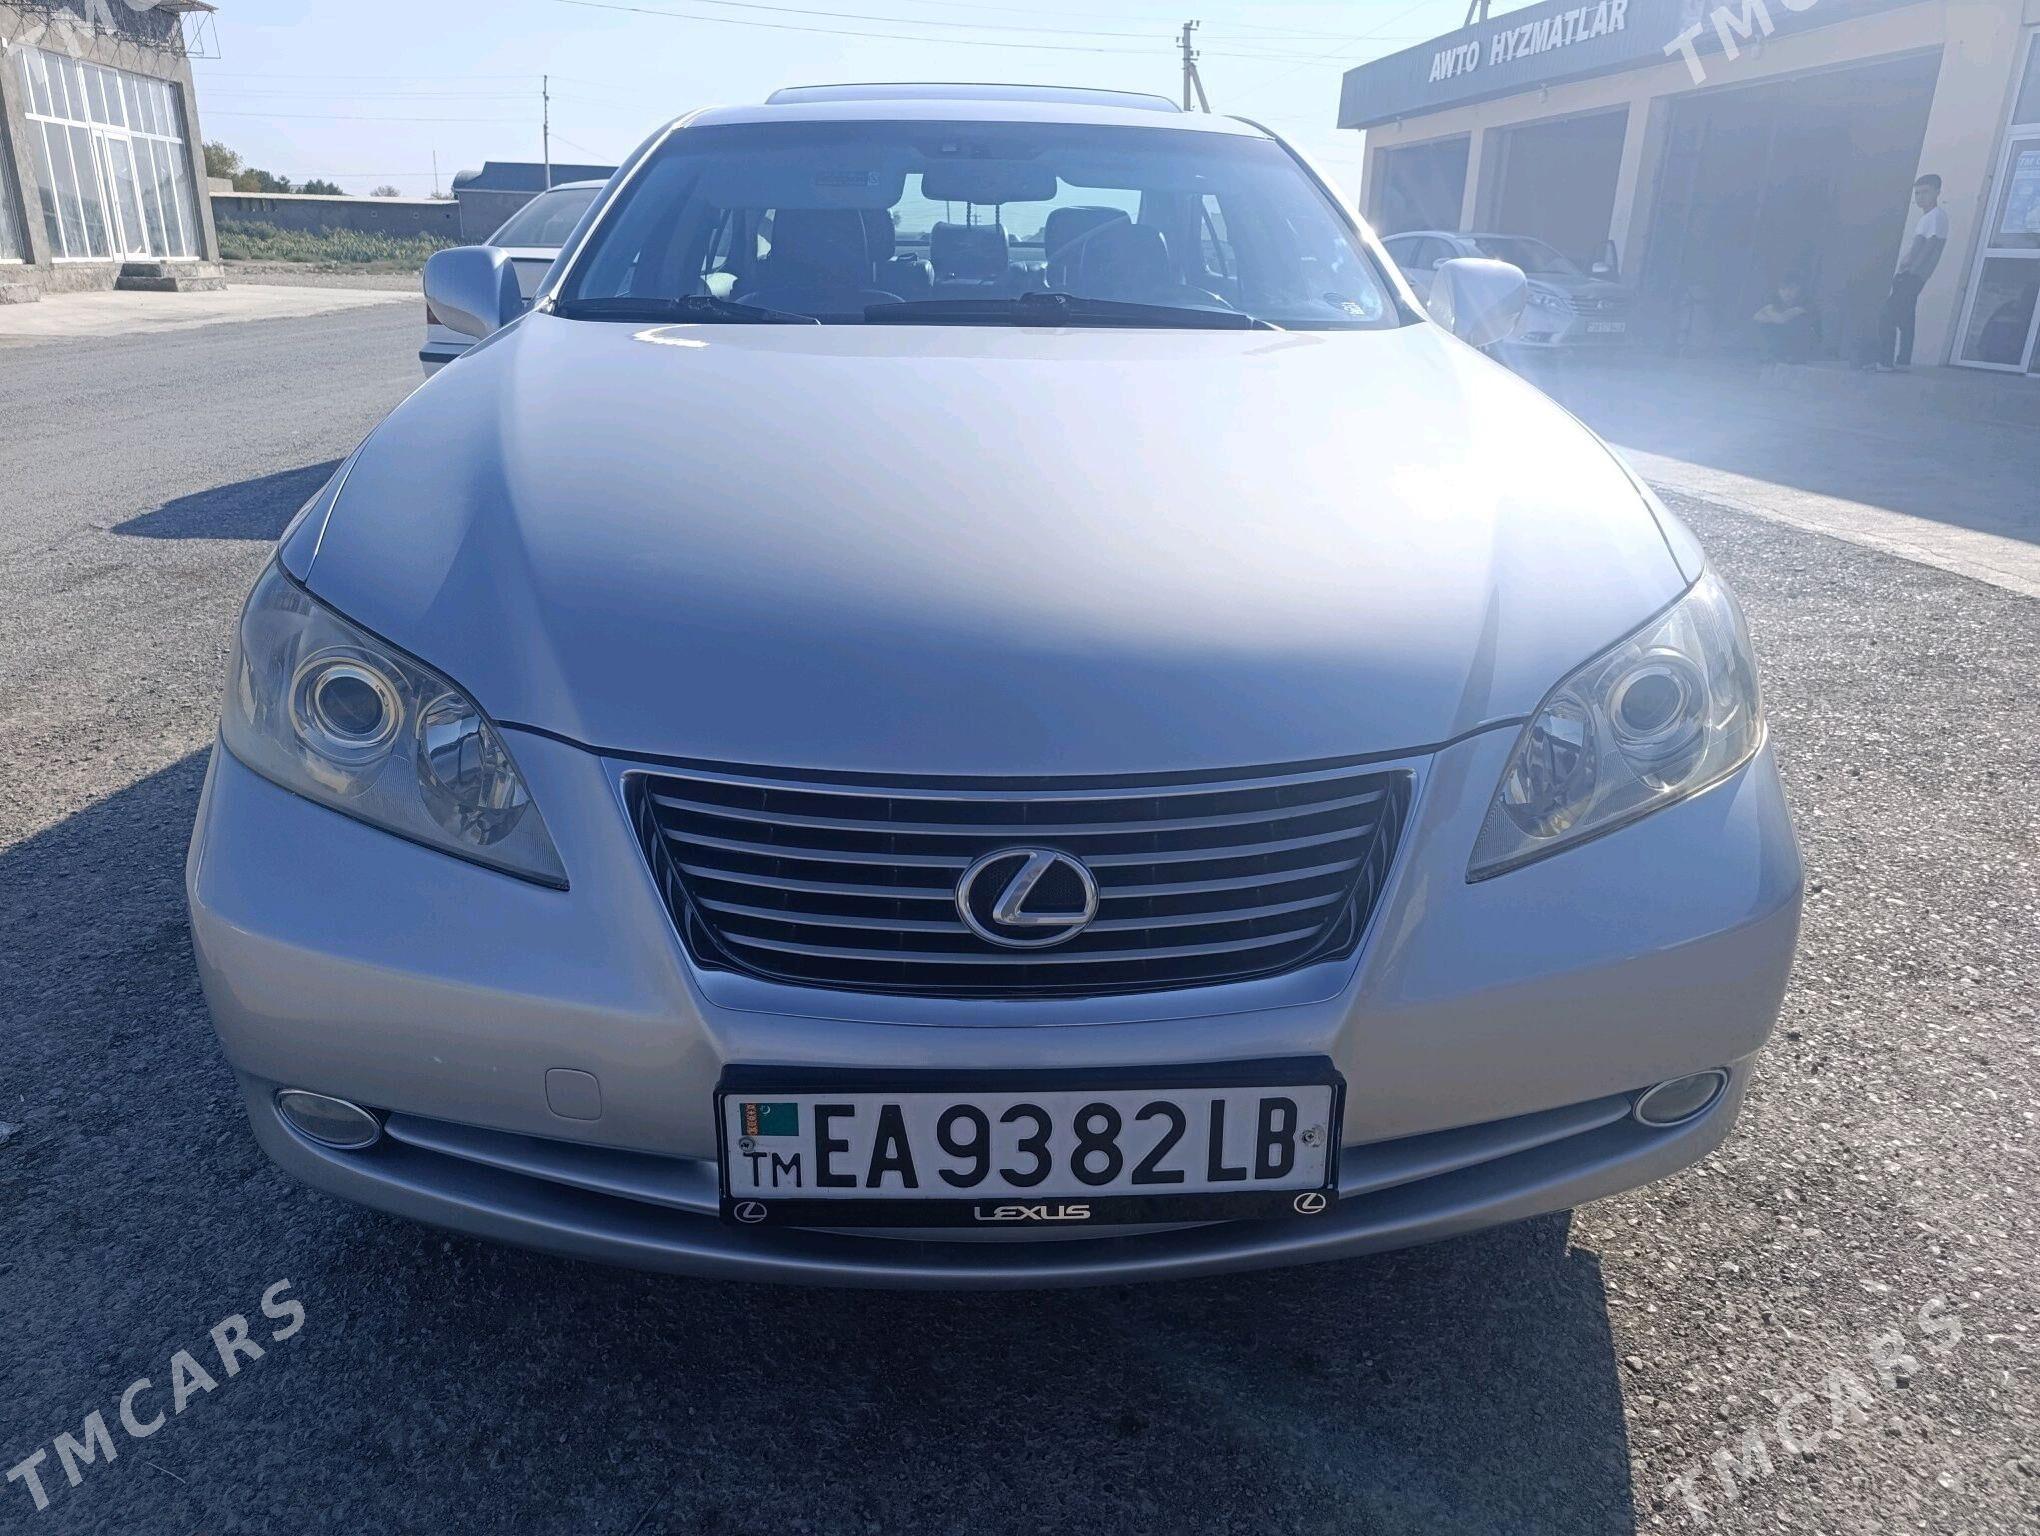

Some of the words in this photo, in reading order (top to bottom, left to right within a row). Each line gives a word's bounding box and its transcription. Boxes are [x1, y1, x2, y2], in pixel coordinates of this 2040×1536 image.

[1428, 40, 1480, 83] AWTO
[1488, 0, 1628, 66] HYZMATLAR
[743, 1151, 802, 1188] TM
[974, 1204, 1091, 1221] LEXUS
